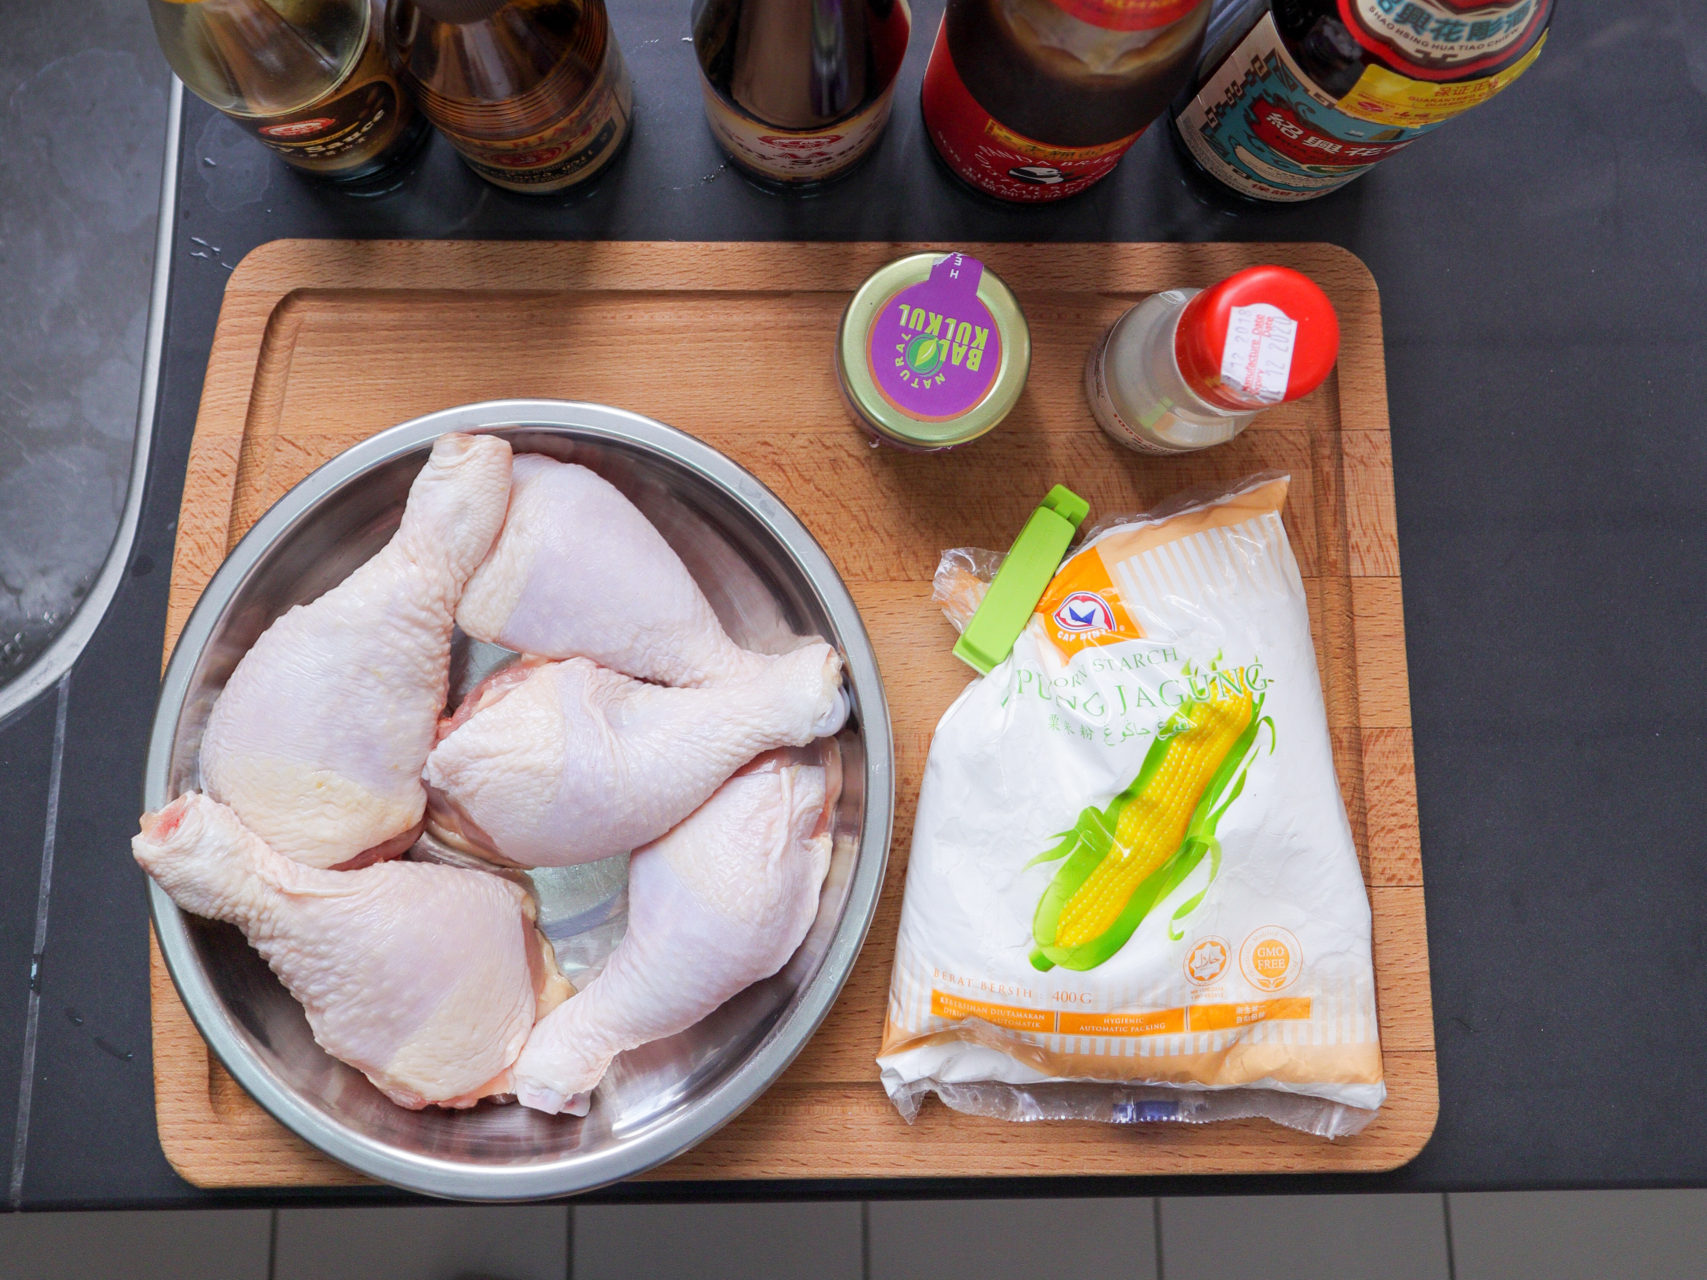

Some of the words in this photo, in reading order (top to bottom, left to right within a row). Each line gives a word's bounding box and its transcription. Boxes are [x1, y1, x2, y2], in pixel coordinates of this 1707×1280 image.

[1369, 6, 1395, 31] SHAO
[1397, 28, 1430, 48] HSING
[1459, 42, 1485, 51] TIAO
[899, 304, 989, 349] KULKUL
[1251, 314, 1264, 335] Date
[1263, 316, 1274, 337] Date
[895, 332, 946, 389] NATURAL
[1057, 631, 1076, 642] CAP
[1050, 664, 1088, 688] ORN
[1092, 647, 1179, 673] STARCH
[1115, 663, 1270, 716] JAGUNG
[1257, 947, 1285, 957] GMO
[1258, 959, 1286, 970] FREE
[933, 968, 973, 987] BERAT
[980, 980, 1032, 999] BERSIH
[1052, 991, 1077, 1003] 400
[990, 1008, 1045, 1020] DIUTAMAKAN
[1079, 1025, 1129, 1033] AUTOMATIC
[1131, 1022, 1166, 1032] PACKING
